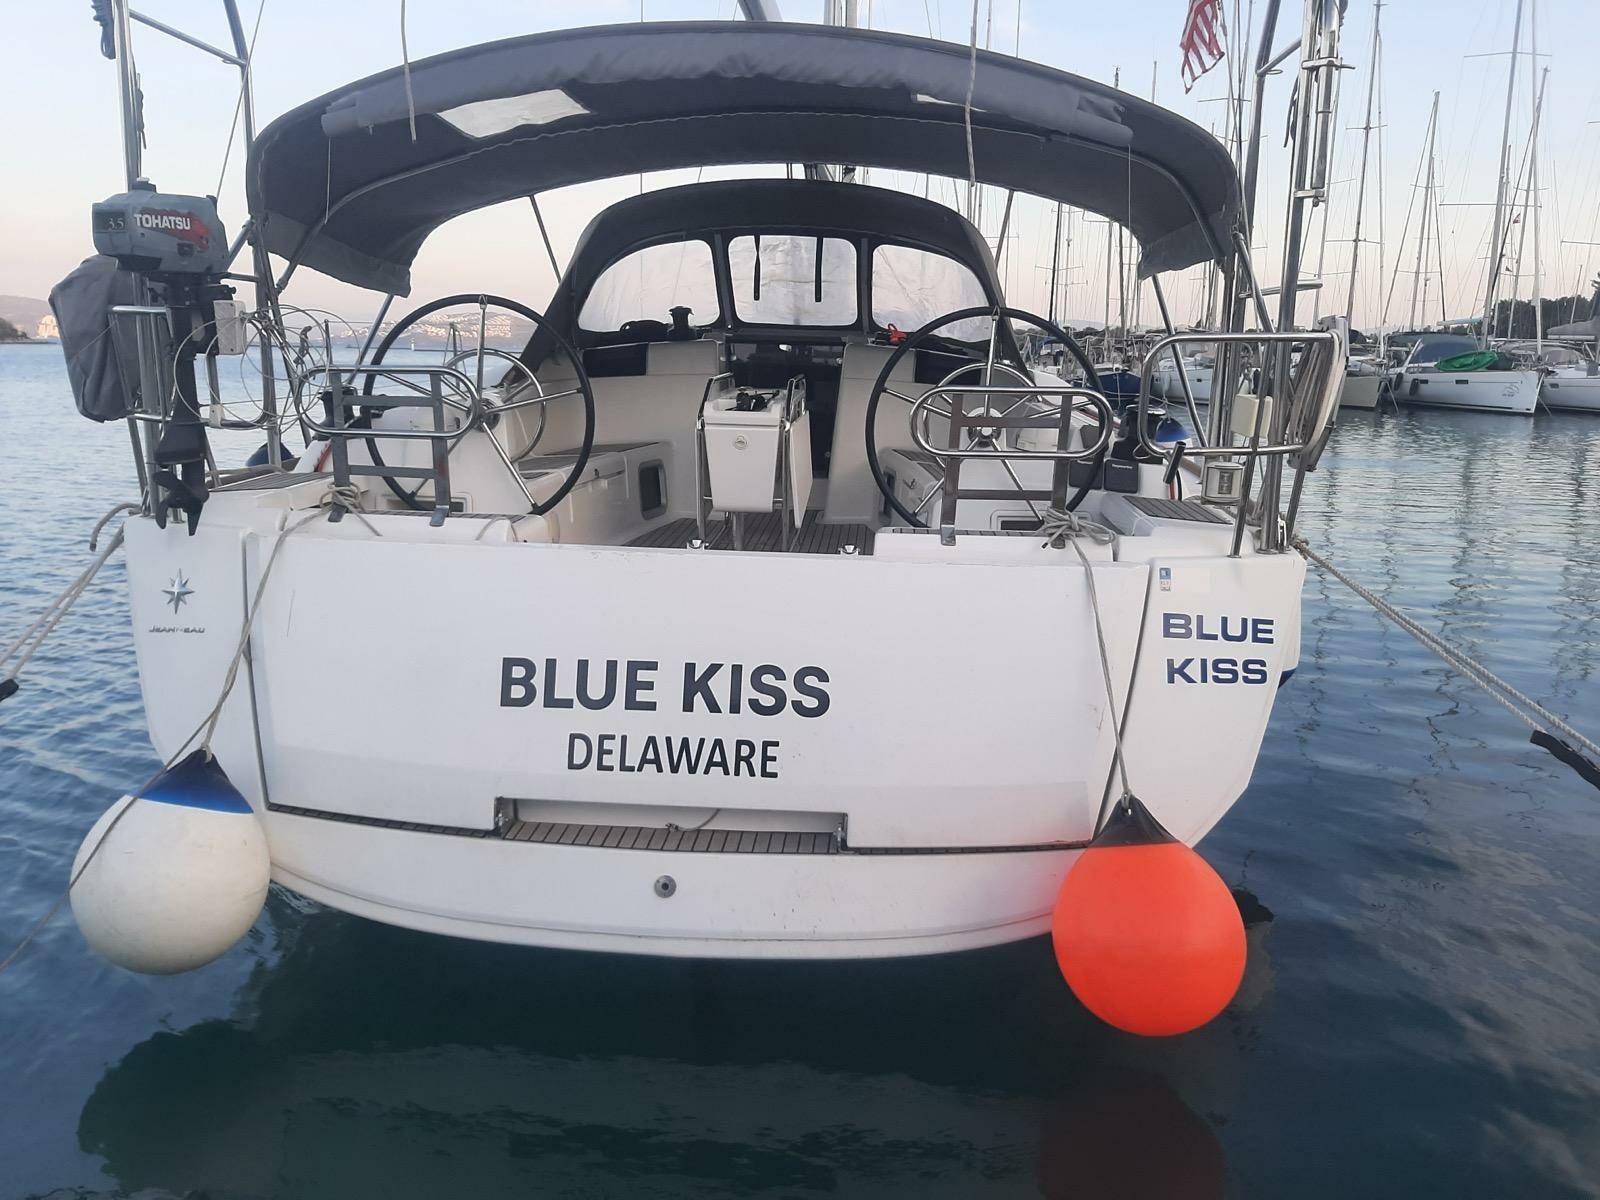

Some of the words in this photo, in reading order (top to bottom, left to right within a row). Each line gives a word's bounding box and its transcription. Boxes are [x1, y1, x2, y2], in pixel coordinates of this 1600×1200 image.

[134, 213, 191, 230] TOHATSU
[1162, 612, 1274, 645] BLUE
[499, 656, 659, 711] BLUE
[681, 661, 831, 718] KISS
[1166, 657, 1268, 685] KISS
[566, 732, 780, 779] DELAWARE
